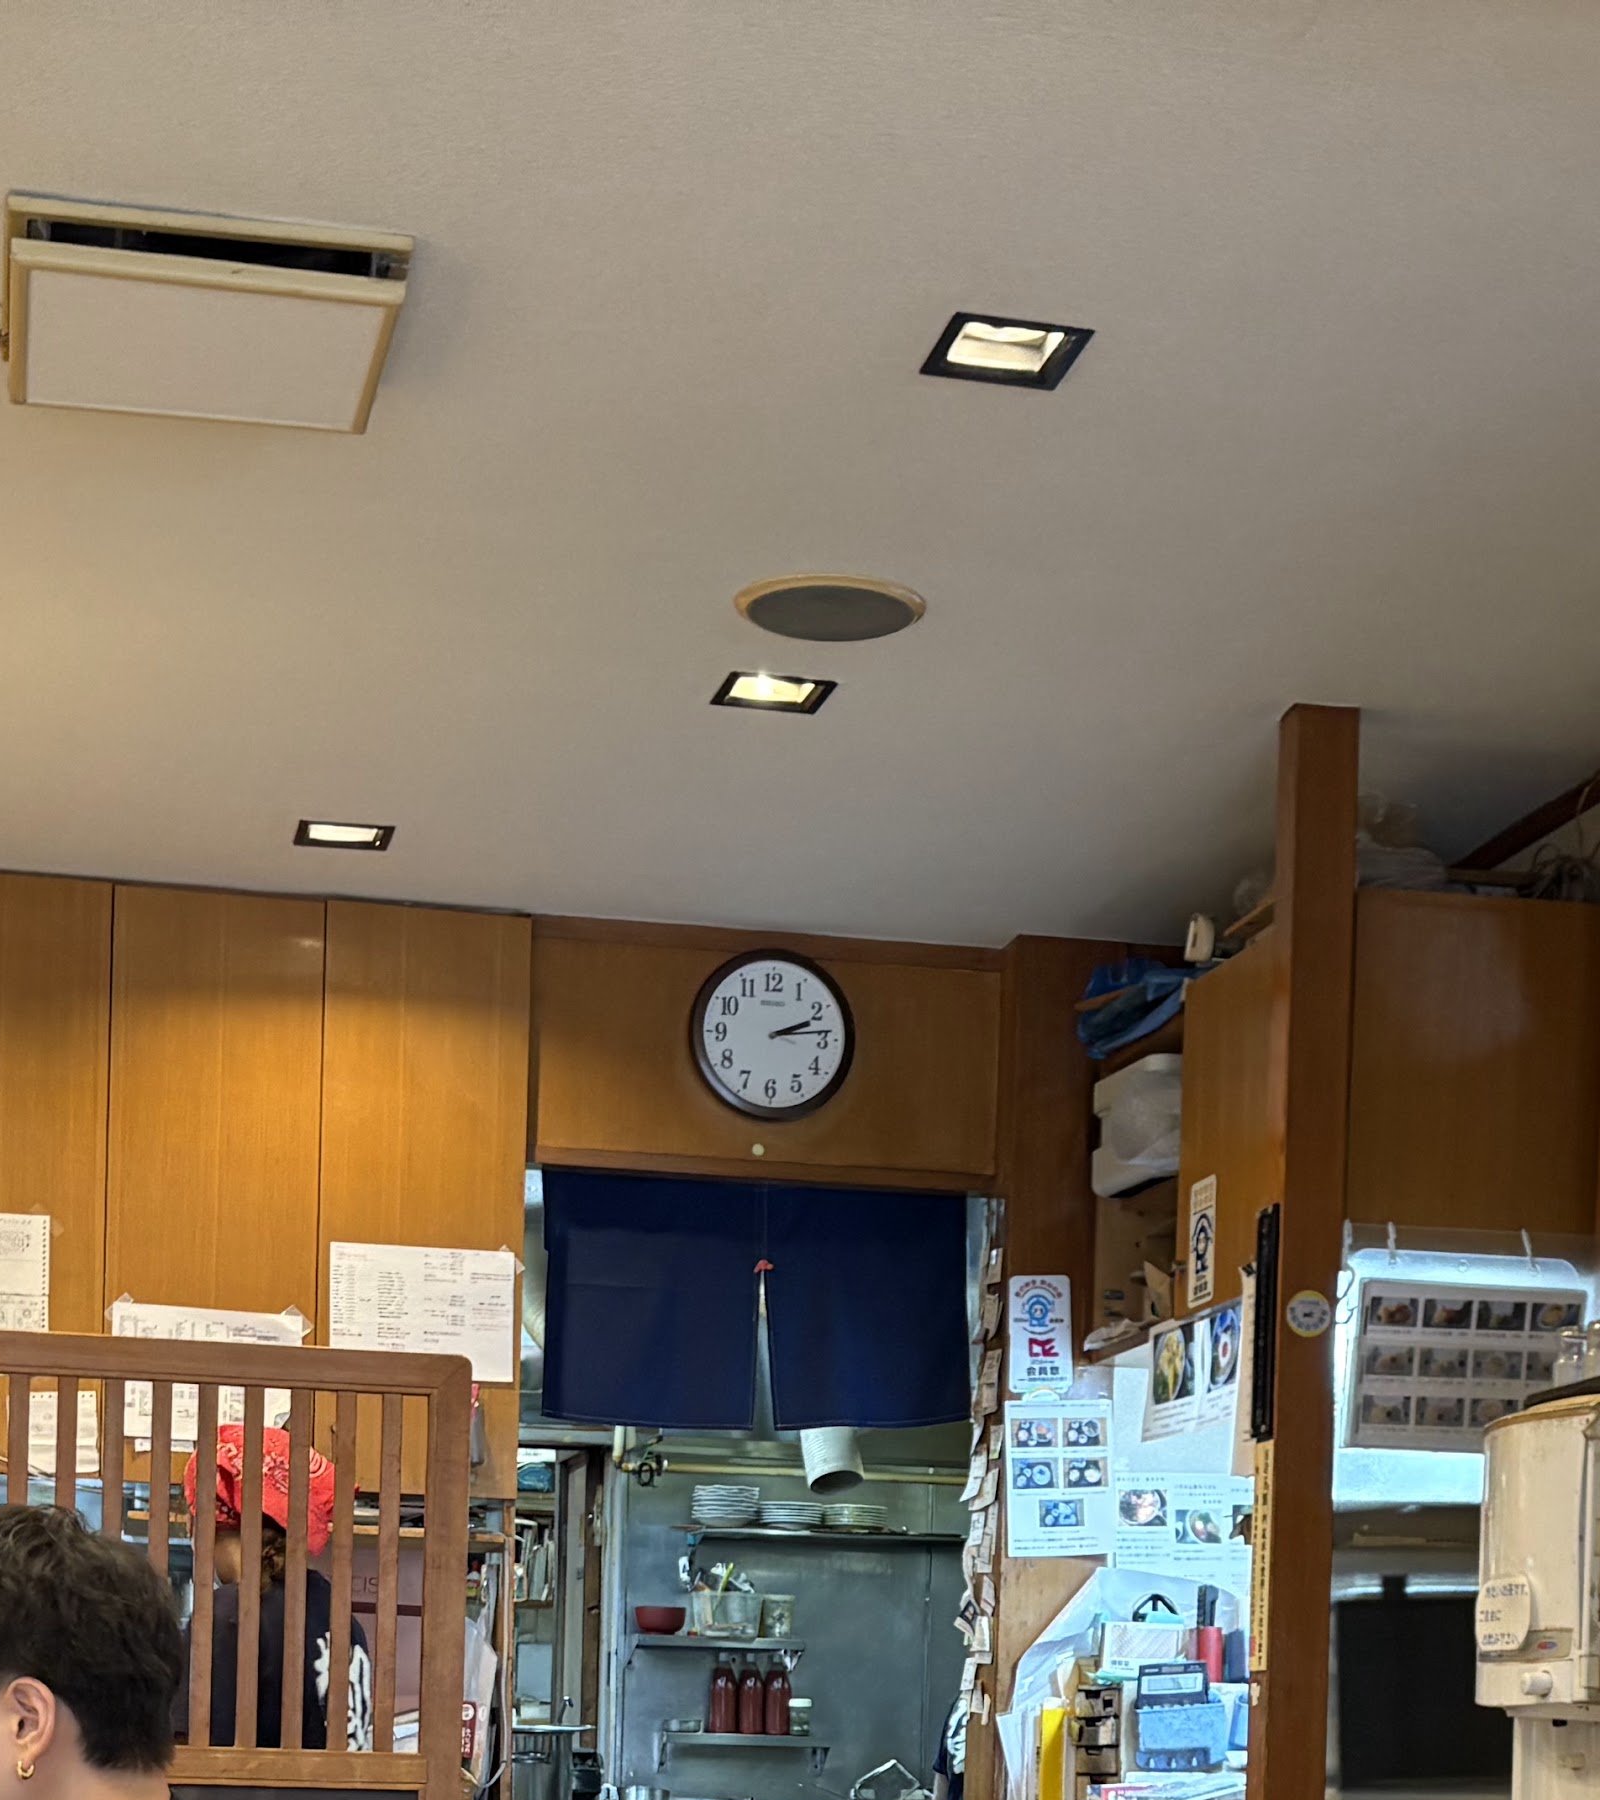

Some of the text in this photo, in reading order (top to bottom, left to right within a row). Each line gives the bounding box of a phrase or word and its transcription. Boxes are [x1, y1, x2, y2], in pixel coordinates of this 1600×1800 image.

[741, 979, 757, 998] 11
[764, 973, 784, 992] 12
[795, 982, 803, 1001] 1
[720, 996, 739, 1016] 10
[811, 1001, 823, 1021] 2
[715, 1022, 727, 1042] 9
[816, 1030, 829, 1050] 3
[720, 1049, 733, 1069] 8
[808, 1056, 821, 1075] 4
[739, 1070, 752, 1089] 7
[764, 1078, 776, 1099] 6
[790, 1074, 802, 1093] 5
